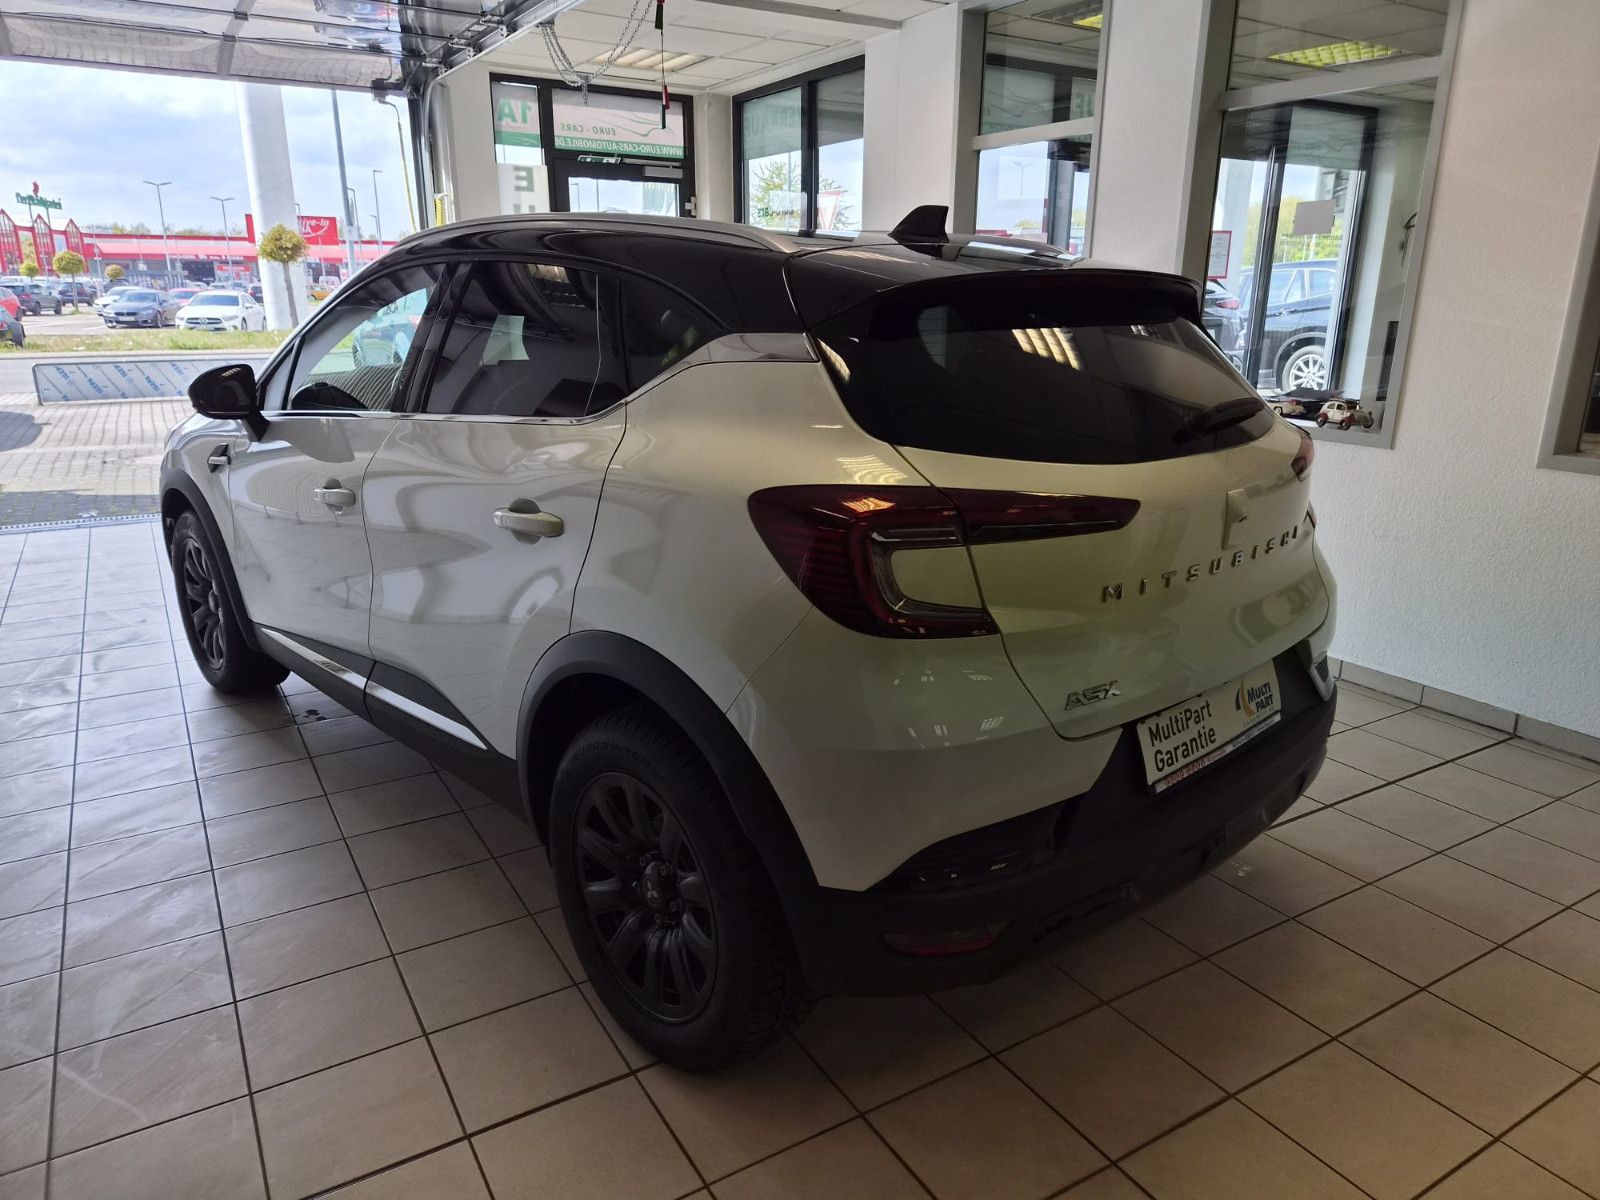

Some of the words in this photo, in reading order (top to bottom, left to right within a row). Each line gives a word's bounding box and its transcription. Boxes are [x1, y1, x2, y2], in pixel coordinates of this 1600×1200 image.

[1101, 524, 1298, 603] MITSUBISHI
[1064, 680, 1122, 711] ASX
[1247, 681, 1272, 705] MULTI
[1255, 694, 1274, 712] PART
[1148, 700, 1212, 747] MultiPart
[1154, 725, 1217, 773] Garantie
